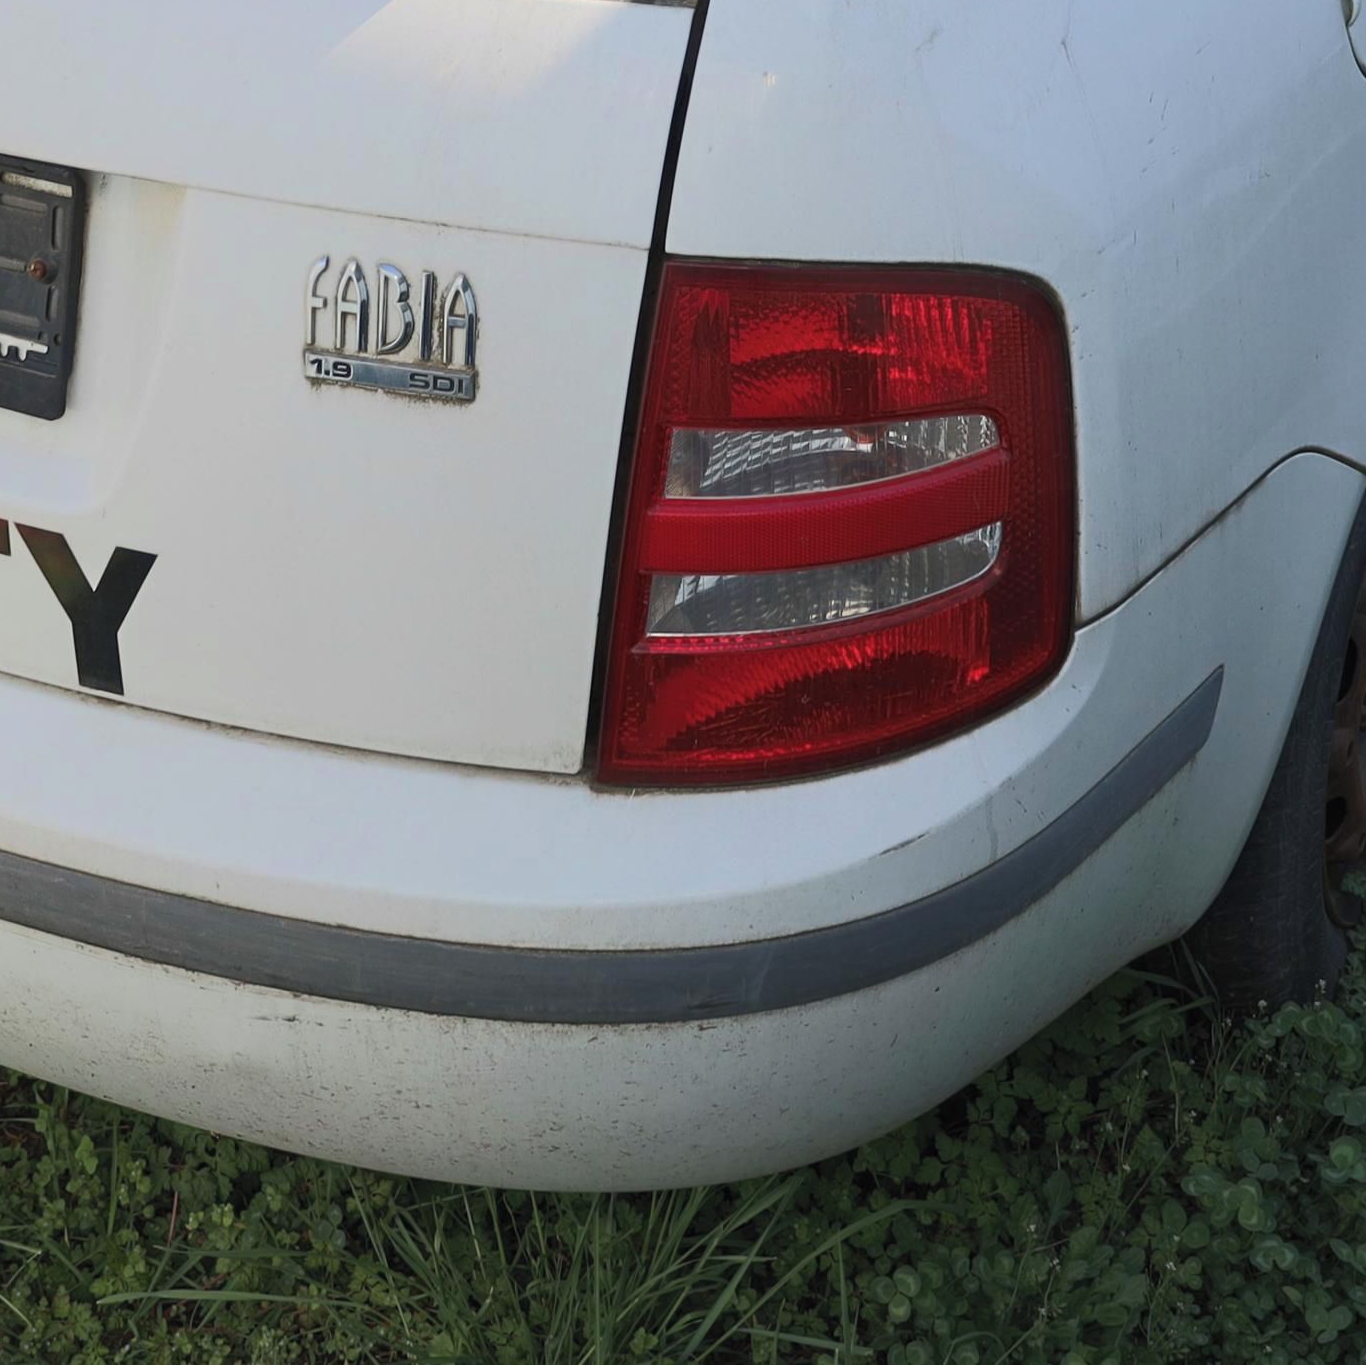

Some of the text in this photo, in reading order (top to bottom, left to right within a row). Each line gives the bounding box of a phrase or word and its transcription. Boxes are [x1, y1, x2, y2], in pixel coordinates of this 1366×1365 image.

[307, 254, 477, 367] FABIA
[309, 357, 464, 395] 1.9 SDI
